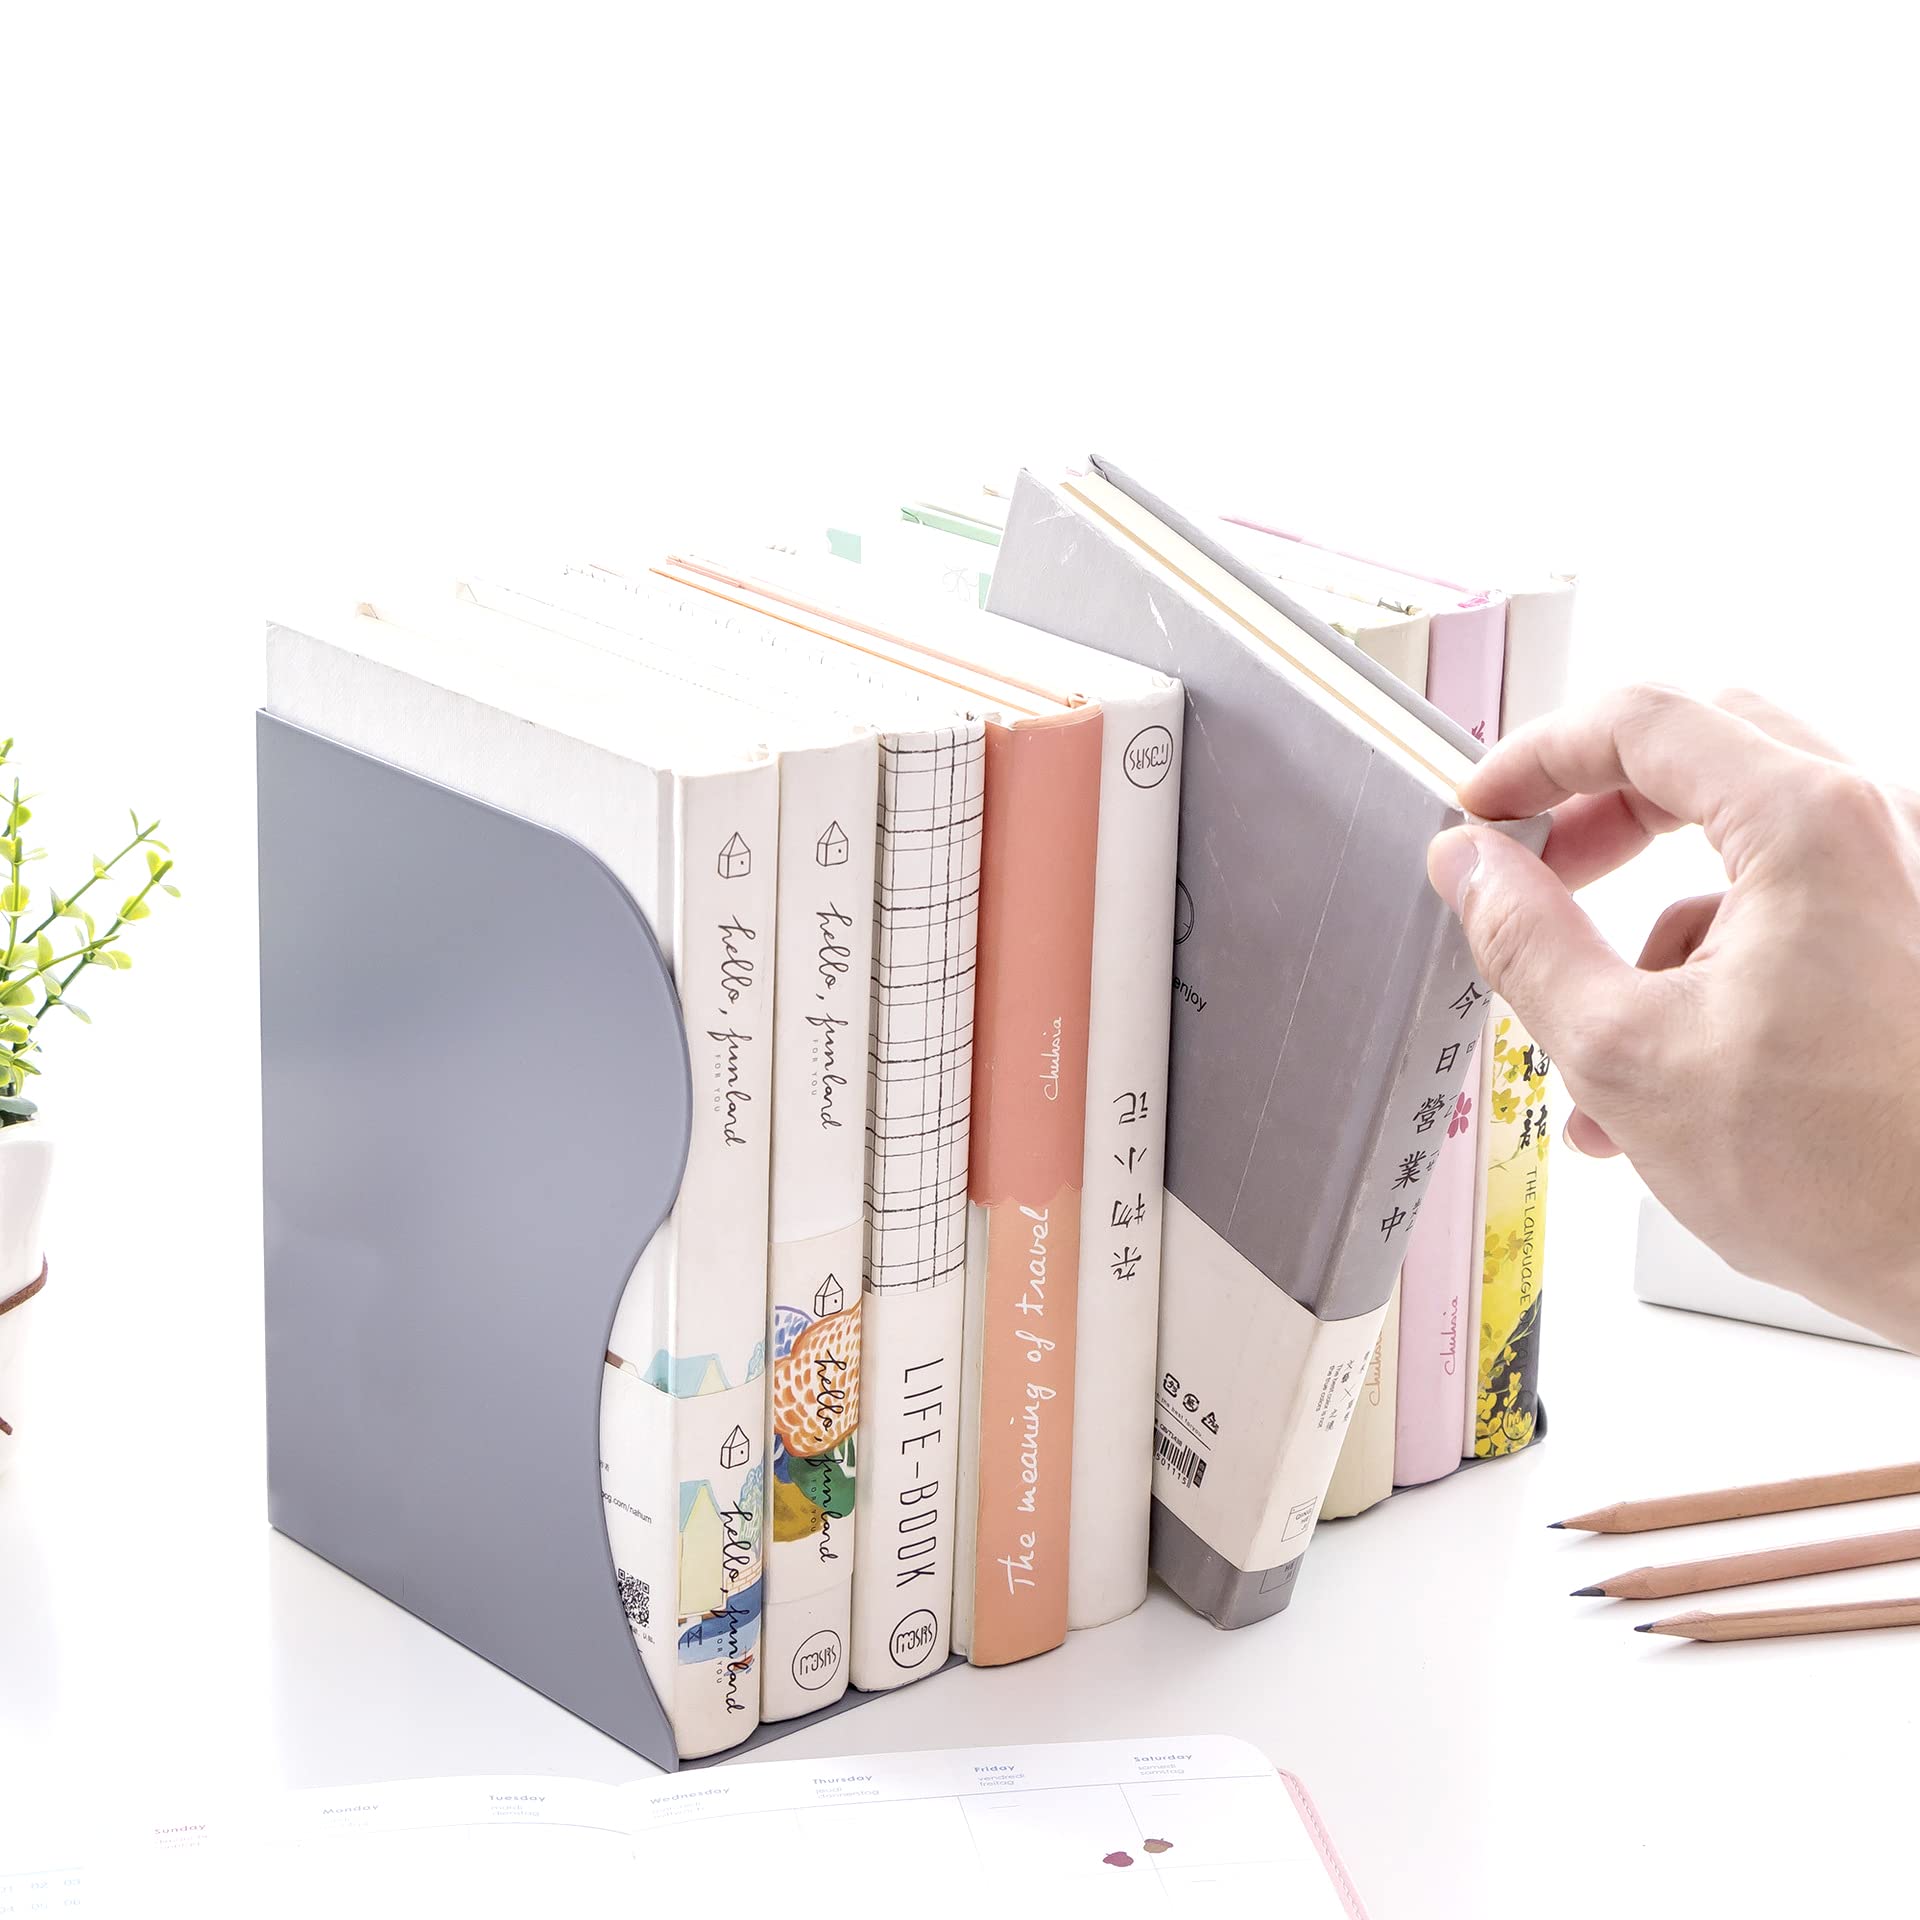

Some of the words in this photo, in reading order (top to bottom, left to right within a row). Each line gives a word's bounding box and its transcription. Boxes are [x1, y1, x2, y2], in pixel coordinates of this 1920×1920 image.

[1172, 973, 1208, 1012] enjoy
[810, 1070, 819, 1097] YOU
[713, 1087, 722, 1114] YOU
[1379, 980, 1483, 1243] 今日營業中
[1110, 1091, 1150, 1282] 杂物小记
[1524, 1166, 1538, 1203] THE
[1014, 1206, 1050, 1319] travel
[1026, 1329, 1056, 1365] of
[1008, 1380, 1057, 1512] meaning
[997, 1530, 1036, 1595] The
[973, 1765, 1015, 1774] Friday
[1133, 1754, 1193, 1763] Saturday
[812, 1774, 873, 1785] Thursday
[489, 1795, 546, 1803] Tuesday
[650, 1787, 730, 1804] Wednesday
[322, 1804, 380, 1815] Monday
[154, 1824, 206, 1835] Sunday
